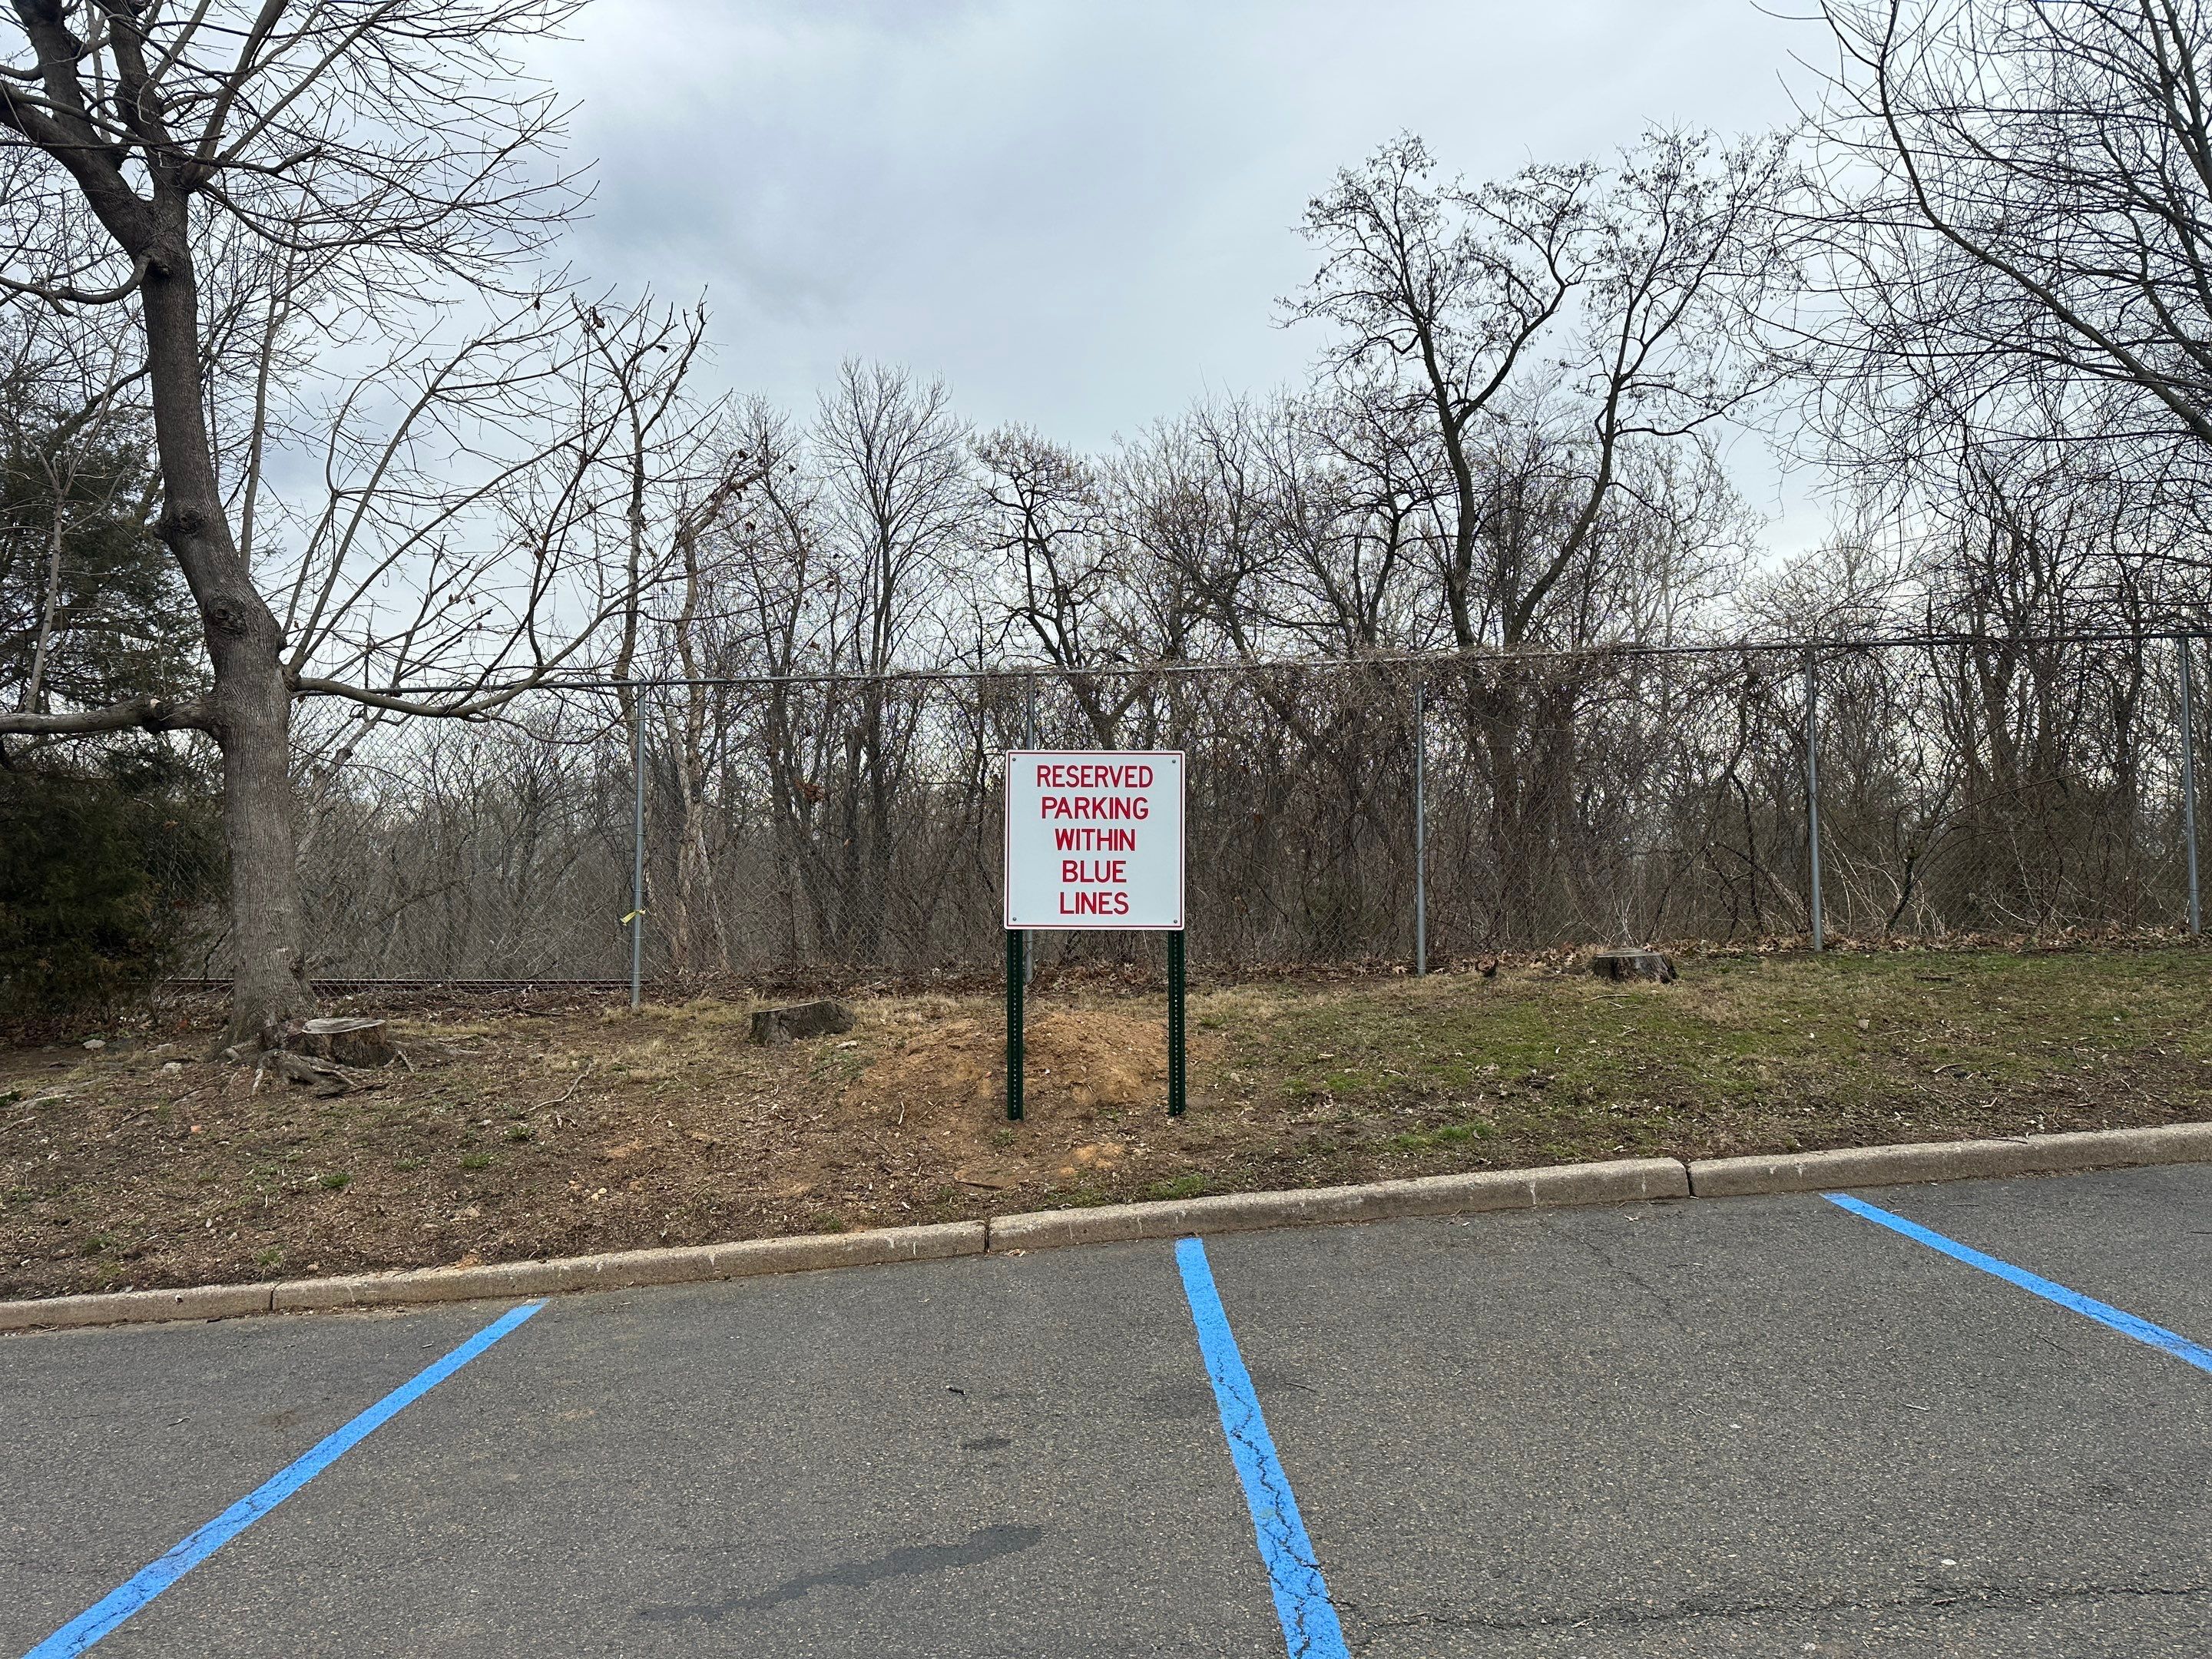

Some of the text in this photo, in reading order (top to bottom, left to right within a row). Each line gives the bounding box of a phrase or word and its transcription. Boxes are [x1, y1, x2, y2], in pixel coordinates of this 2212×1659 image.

[1036, 764, 1154, 788] RESERVED
[1041, 796, 1150, 820] PARKING
[1055, 828, 1136, 851] WITHIN
[1061, 859, 1127, 883] BLUE
[1059, 892, 1129, 916] LINES
